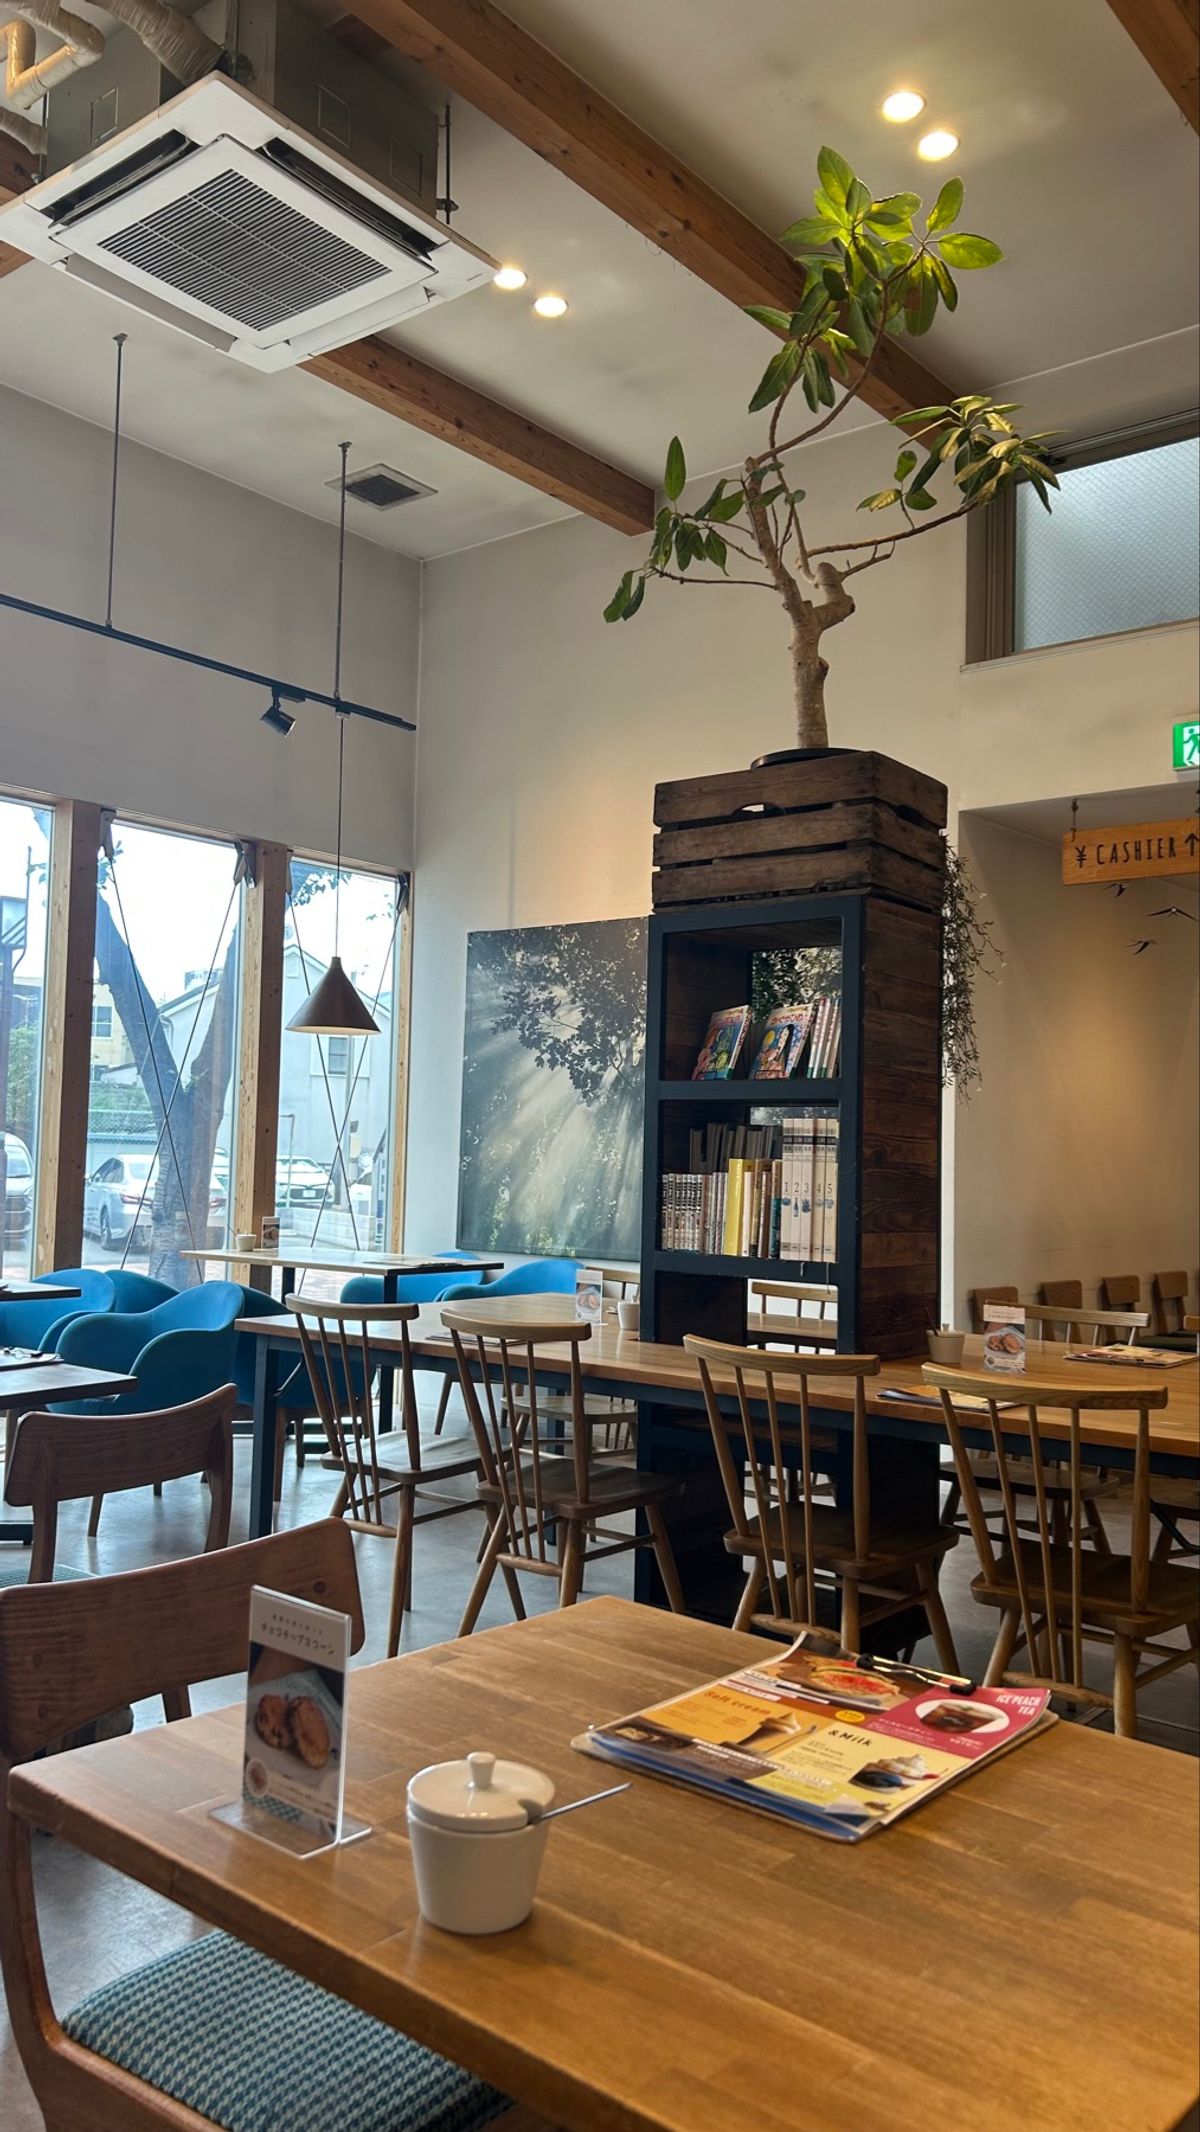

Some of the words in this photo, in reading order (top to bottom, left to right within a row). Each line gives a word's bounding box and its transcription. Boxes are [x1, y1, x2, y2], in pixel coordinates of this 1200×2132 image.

[1075, 846, 1087, 868] ¥
[1096, 837, 1176, 866] CASHIER
[794, 1183, 800, 1193] 2
[804, 1183, 809, 1193] 3
[827, 1184, 832, 1194] 5
[703, 1690, 730, 1704] Soft
[731, 1700, 771, 1716] cream
[996, 1695, 1011, 1704] ICE
[1011, 1695, 1042, 1706] PEACH
[1018, 1706, 1035, 1716] TEA
